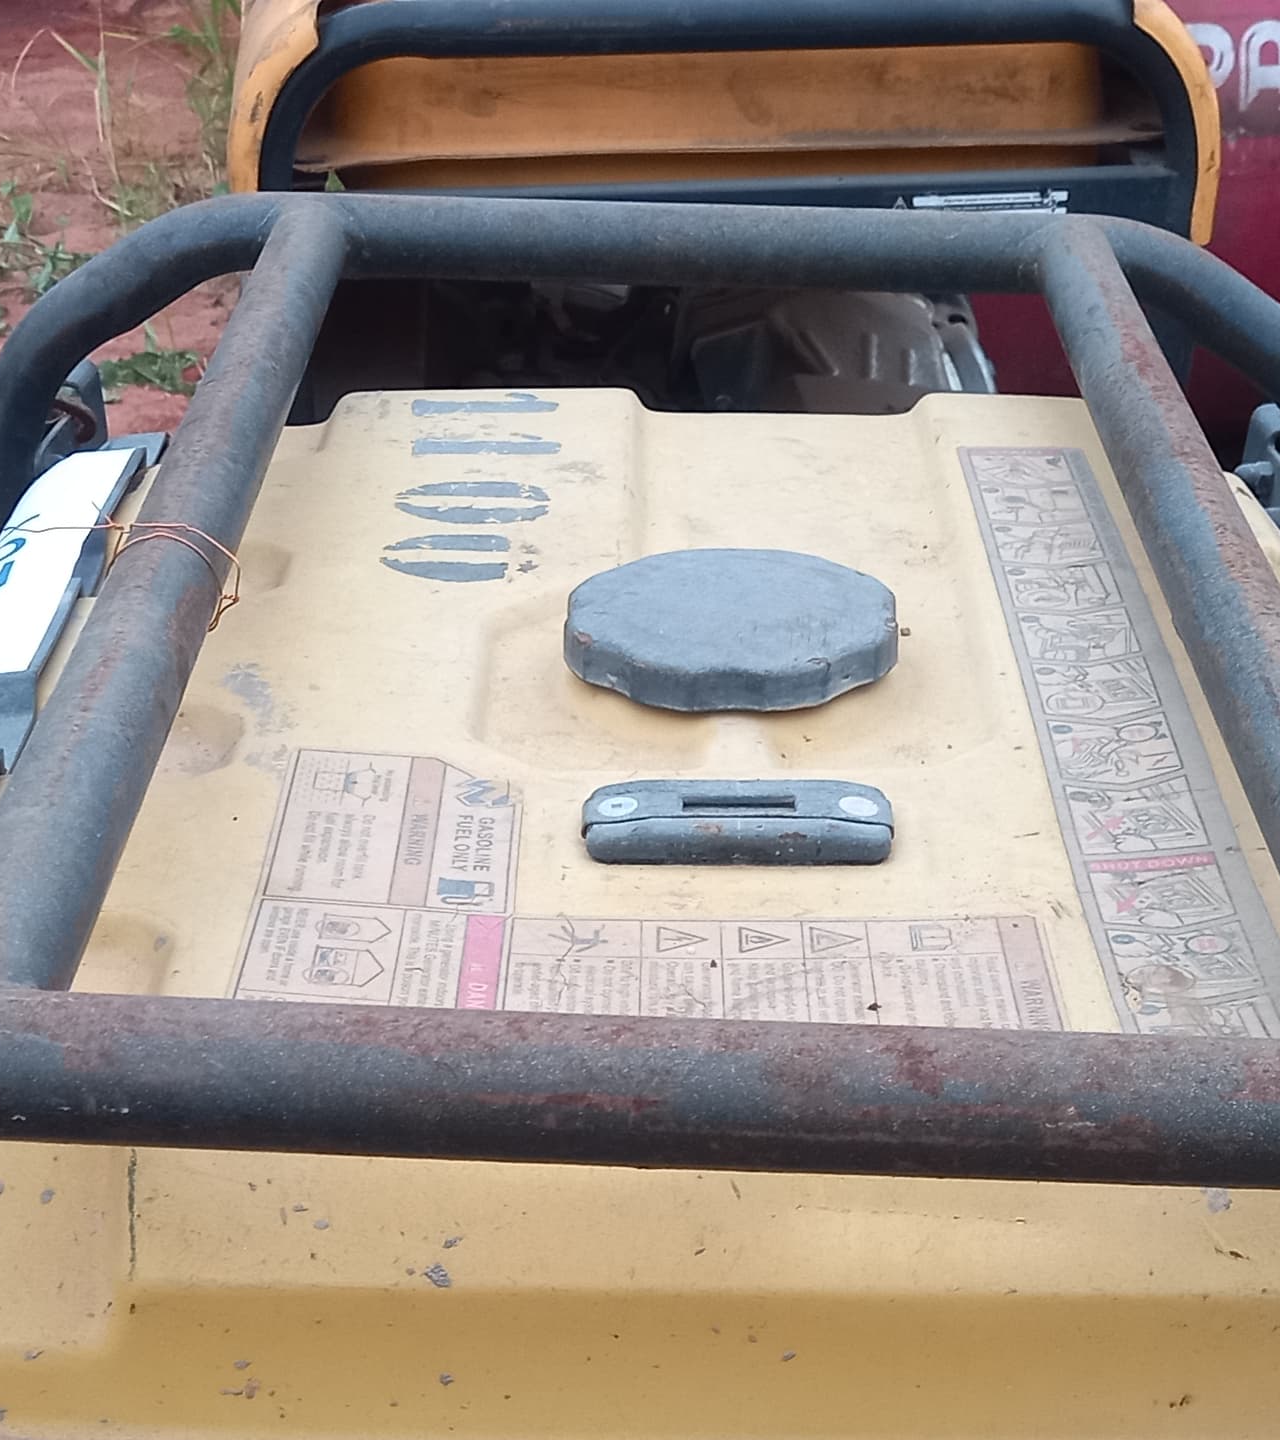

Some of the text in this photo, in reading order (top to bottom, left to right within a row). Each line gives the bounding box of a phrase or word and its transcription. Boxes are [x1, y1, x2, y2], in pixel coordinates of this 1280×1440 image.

[404, 813, 430, 866] WARNING
[449, 814, 475, 872] FUEL ONLY
[473, 816, 495, 872] GASOLINE
